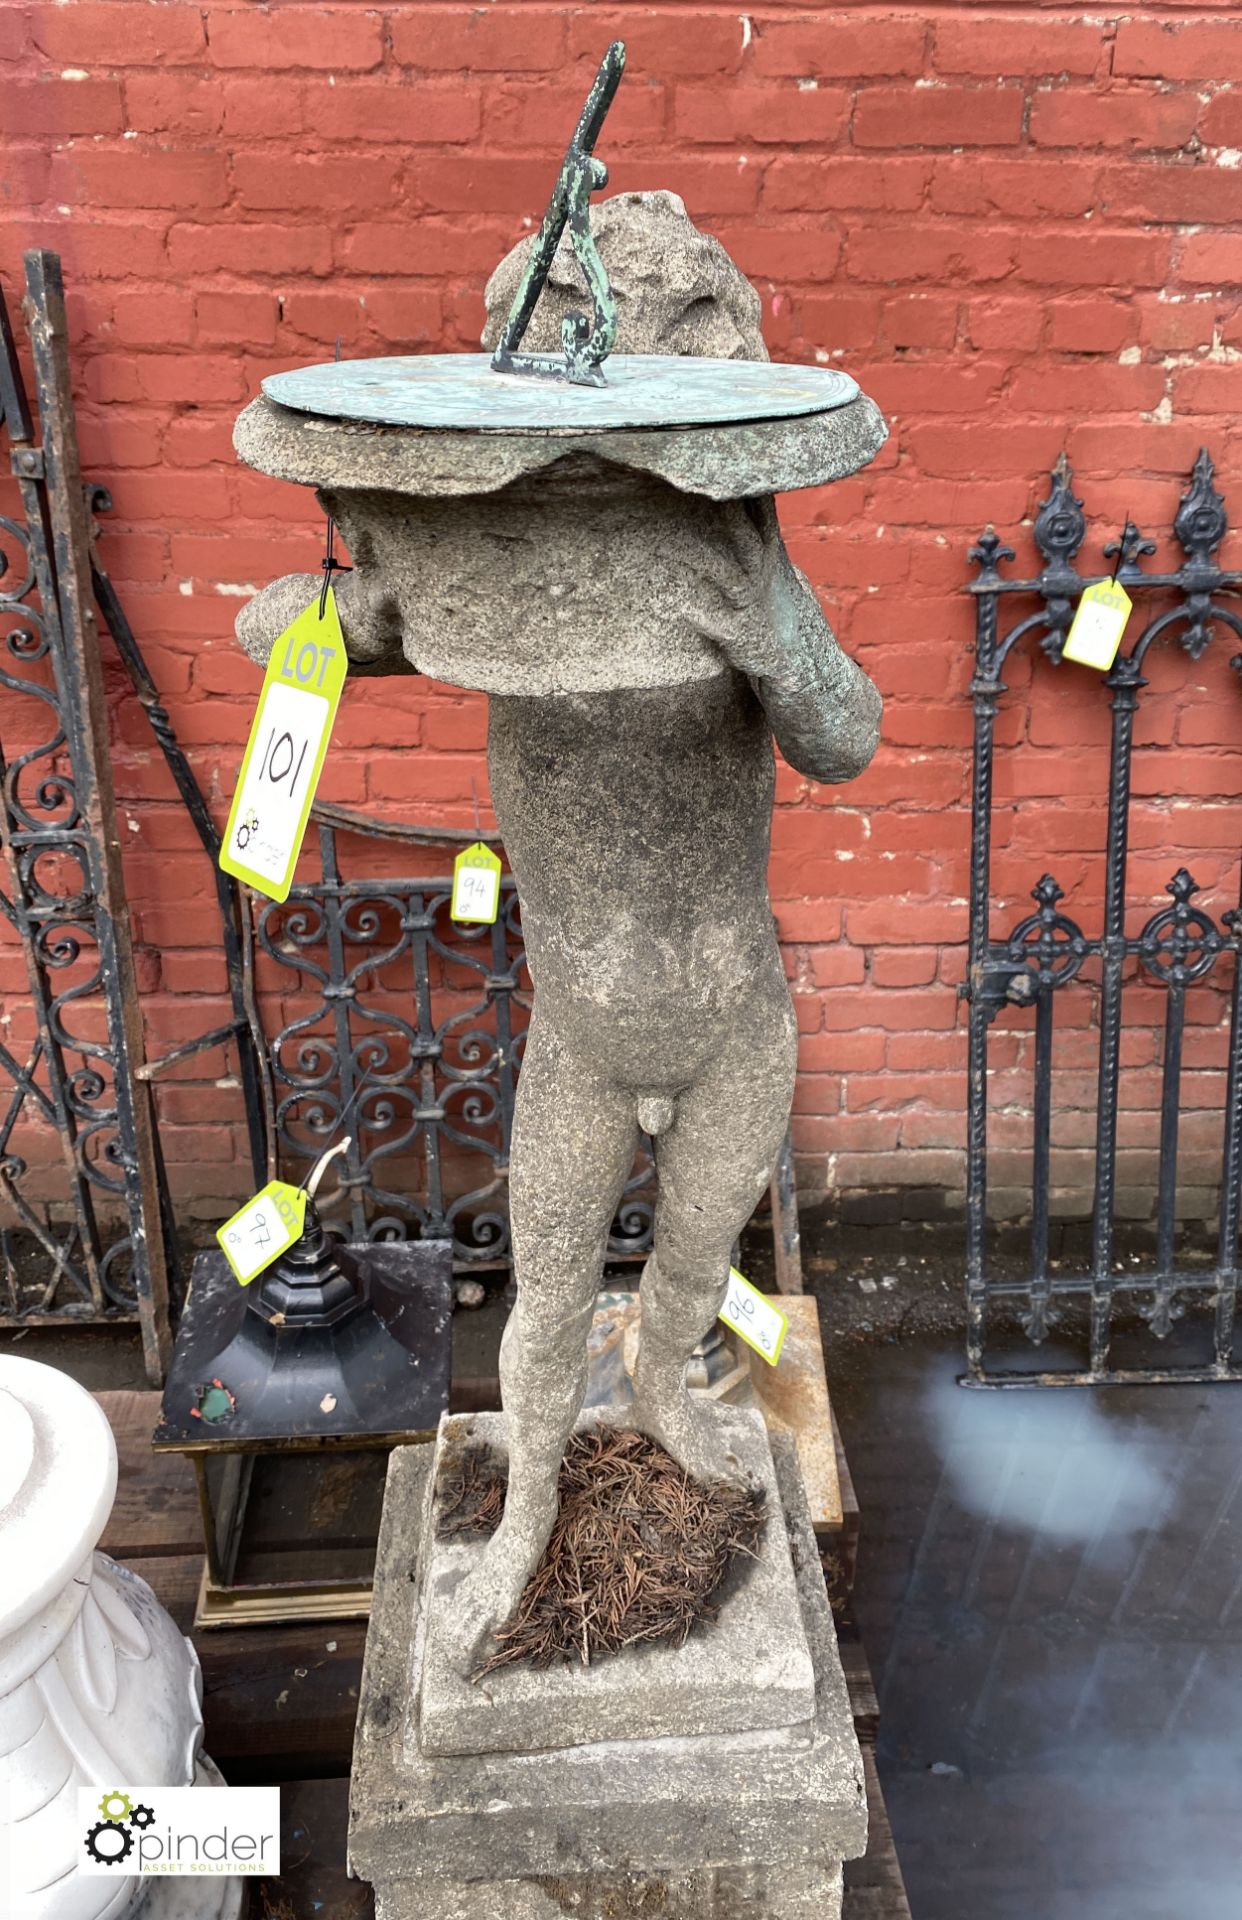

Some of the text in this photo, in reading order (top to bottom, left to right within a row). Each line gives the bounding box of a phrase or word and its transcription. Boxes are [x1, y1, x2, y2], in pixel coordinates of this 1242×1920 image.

[1093, 590, 1124, 608] LOT
[281, 637, 336, 688] LOT
[259, 727, 308, 798] 101
[464, 856, 492, 869] LOT
[463, 877, 485, 898] 94
[272, 1190, 299, 1227] LOT
[249, 1213, 271, 1250] 97
[729, 1289, 755, 1324] 96
